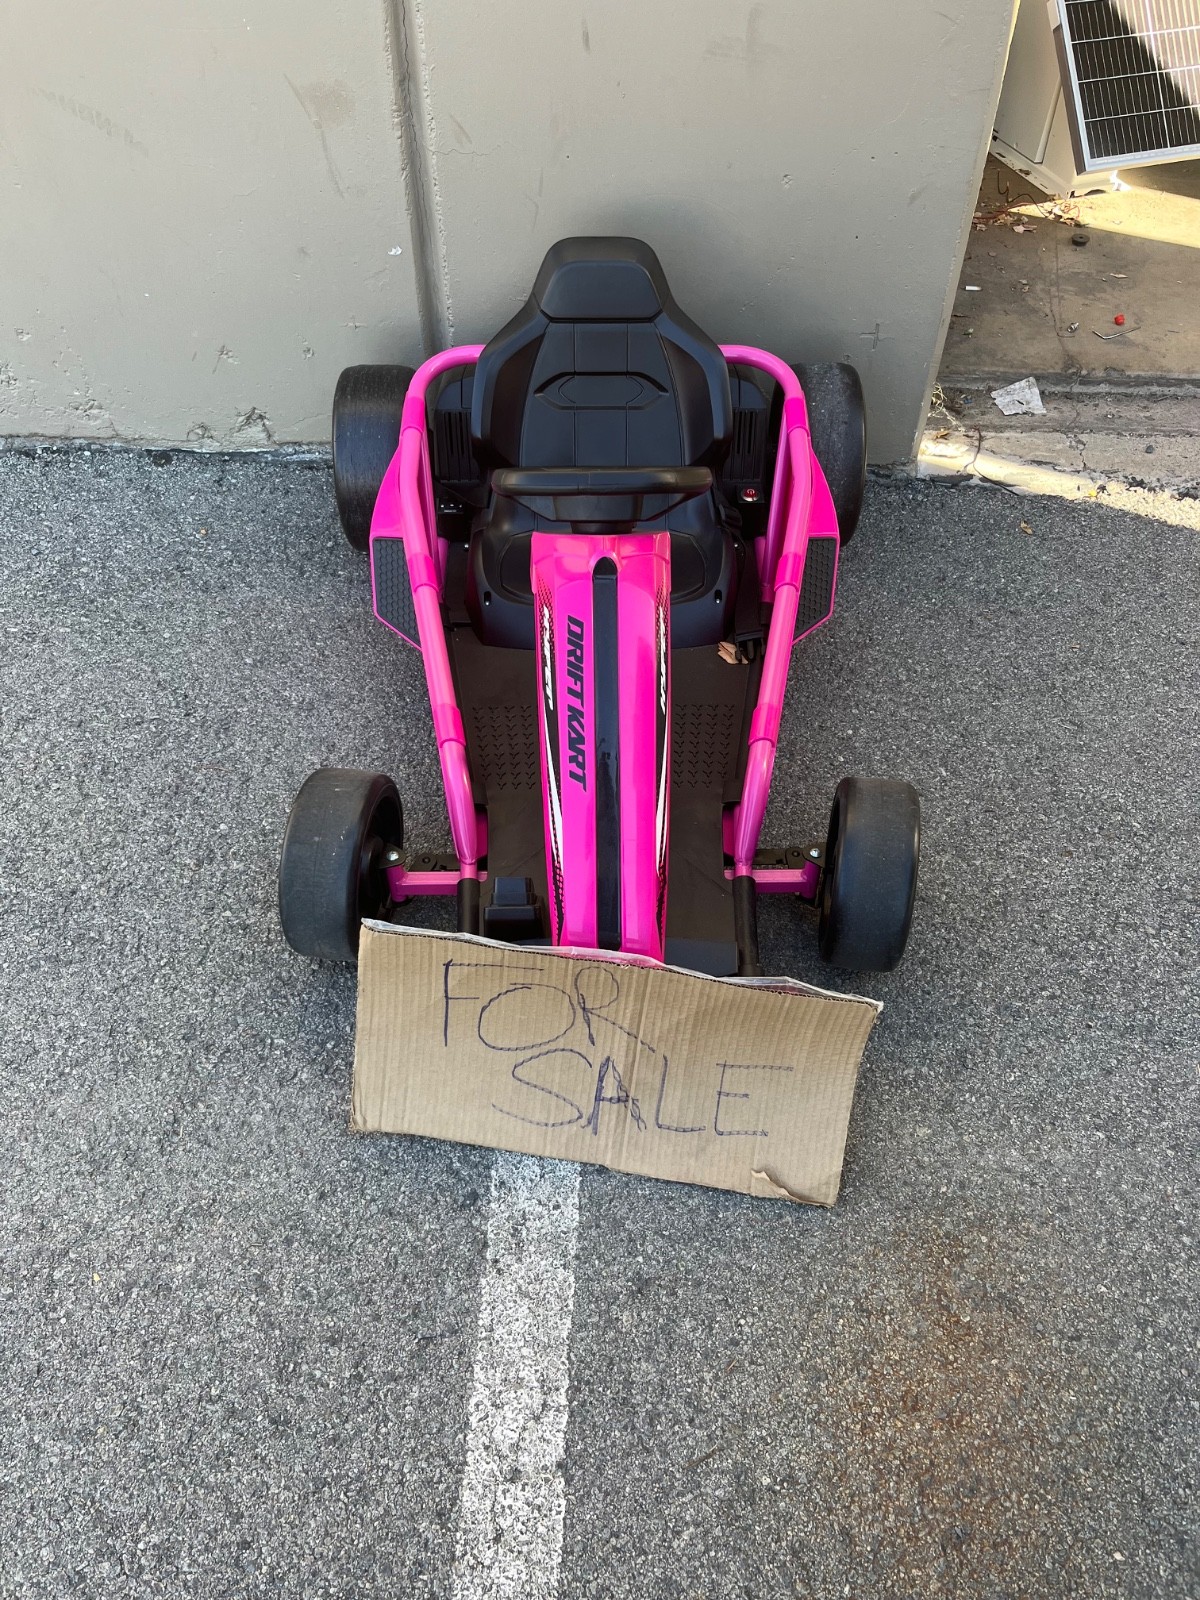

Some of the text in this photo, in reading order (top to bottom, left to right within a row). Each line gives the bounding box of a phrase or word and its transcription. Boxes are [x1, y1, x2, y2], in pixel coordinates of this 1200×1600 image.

[567, 615, 587, 792] DRIFT KART
[443, 957, 656, 1053] FOR
[491, 1047, 794, 1136] SALE
